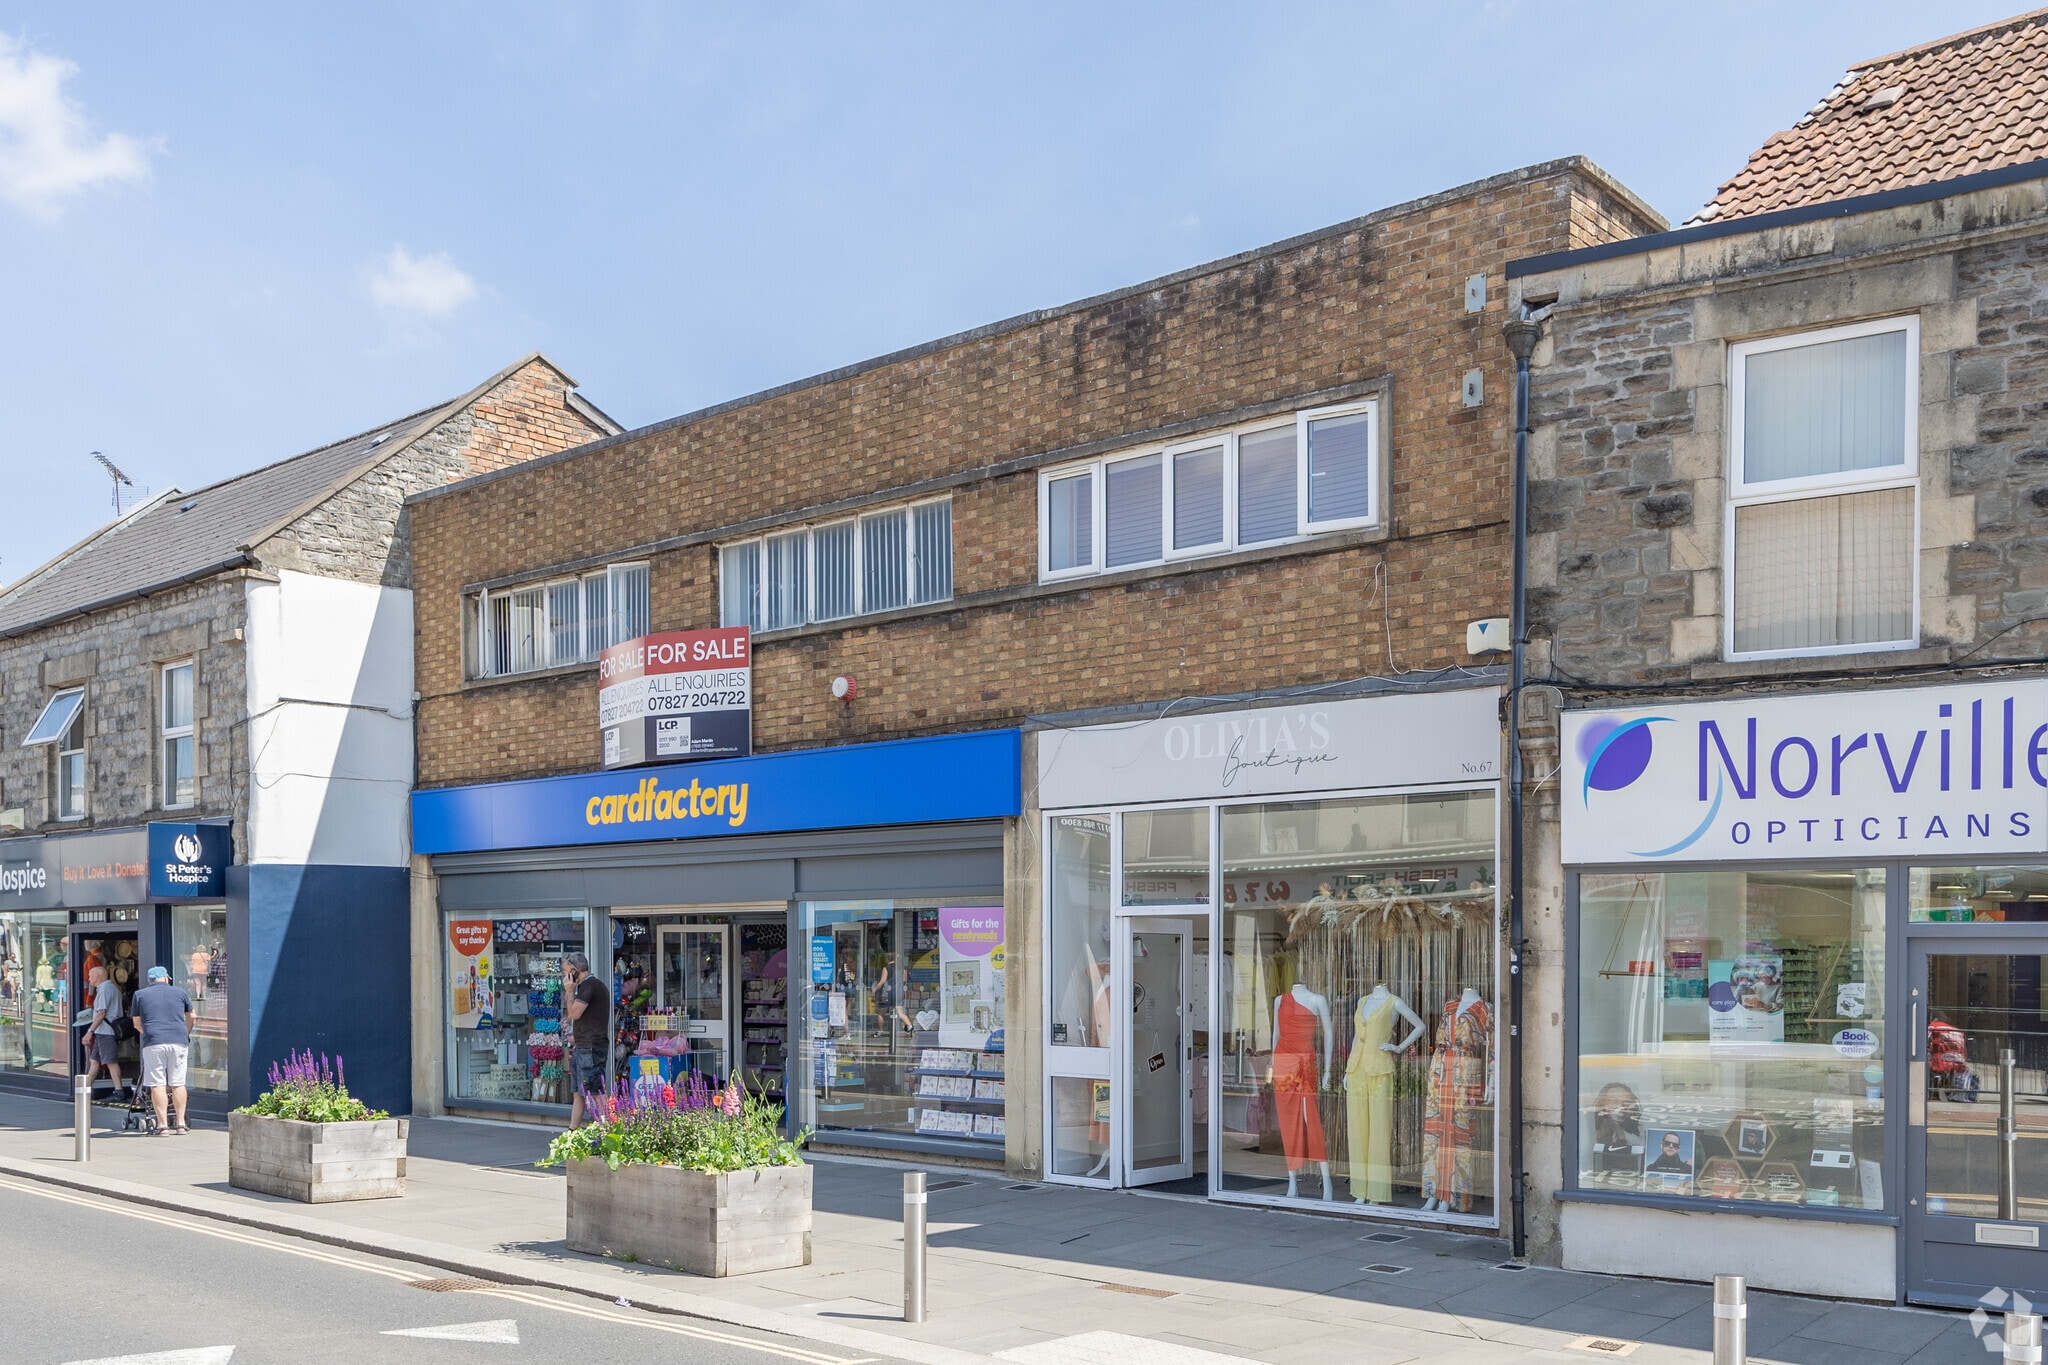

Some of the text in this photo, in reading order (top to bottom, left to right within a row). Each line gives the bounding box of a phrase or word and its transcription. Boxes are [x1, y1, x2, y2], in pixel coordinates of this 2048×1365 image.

[647, 637, 746, 665] FOR SALE
[600, 646, 644, 681] FOR SALE
[648, 672, 746, 693] ALL ENQUIRIES
[648, 690, 746, 711] 07827 204722
[601, 699, 644, 724] 07827 204722
[1163, 711, 1330, 761] OLIVIA'S
[1222, 735, 1338, 788] Boutique
[1461, 761, 1492, 774] No.67
[585, 777, 749, 827] cardfactory
[1730, 811, 2032, 846] OPTICIANS
[64, 866, 78, 884] Buy
[78, 865, 84, 879] it
[87, 865, 105, 880] Love
[106, 864, 112, 879] it
[115, 862, 144, 878] Donate
[165, 863, 212, 874] St Peter's
[169, 873, 209, 884] Hospice
[456, 926, 488, 936] Great gifts to
[951, 918, 999, 929] Gifts for the
[459, 936, 486, 946] say thanks
[952, 930, 998, 941] newlyweds
[1842, 1031, 1869, 1040] Book
[1841, 1045, 1870, 1054] online
